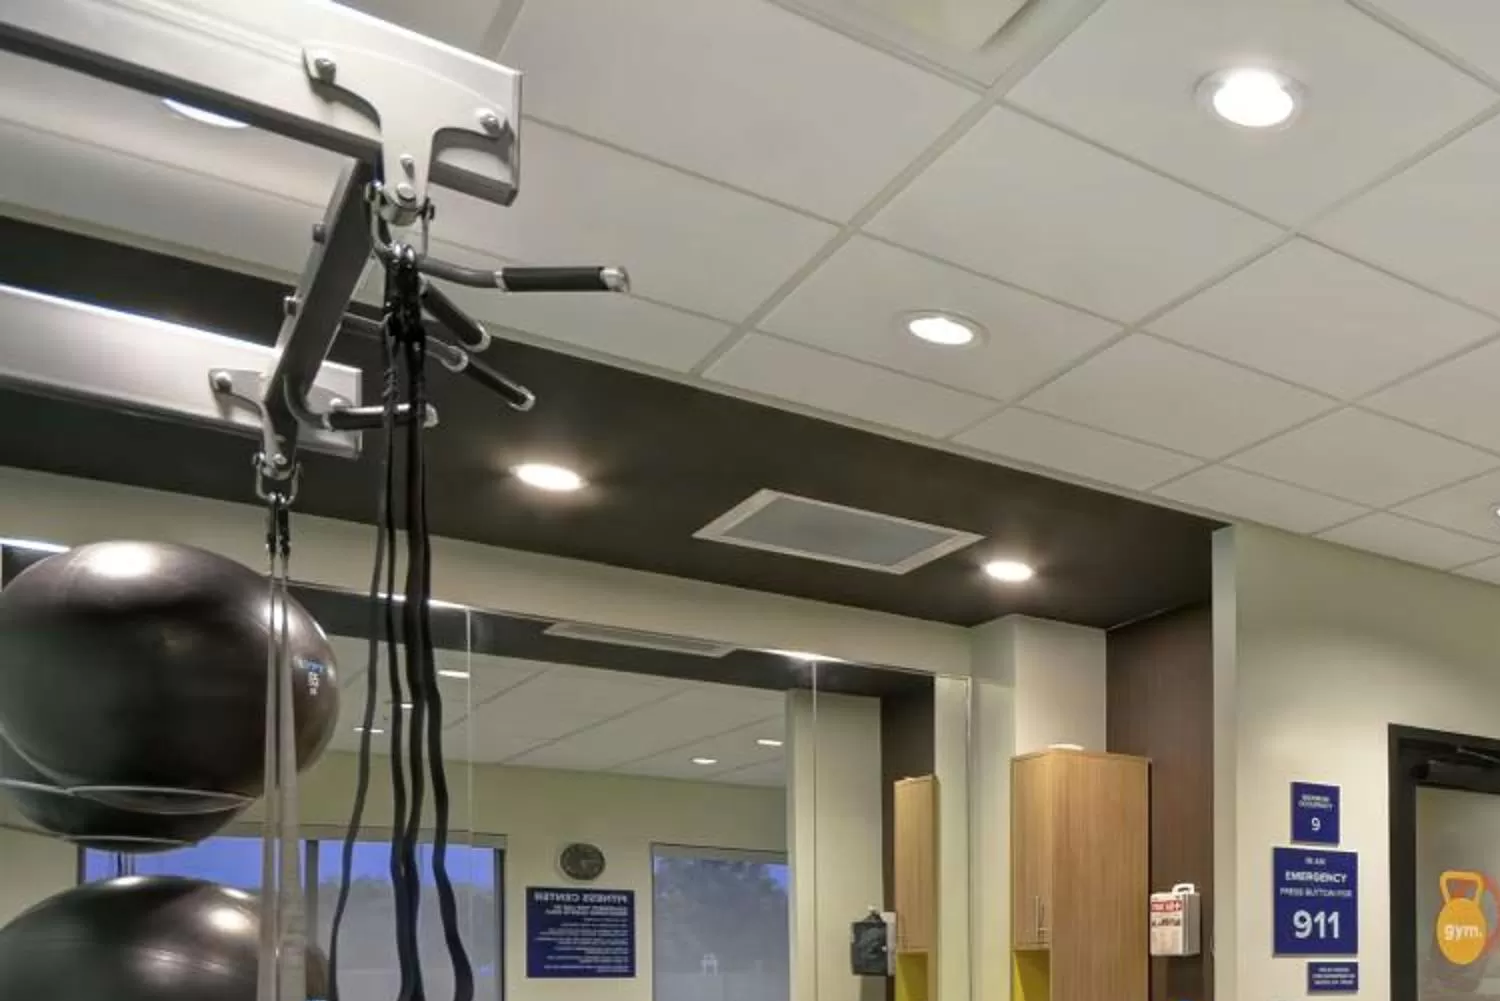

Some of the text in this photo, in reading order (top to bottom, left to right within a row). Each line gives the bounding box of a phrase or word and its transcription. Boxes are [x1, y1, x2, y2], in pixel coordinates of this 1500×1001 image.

[1311, 817, 1321, 832] 9
[1285, 871, 1348, 883] EMERGENCY
[1293, 909, 1340, 939] 911
